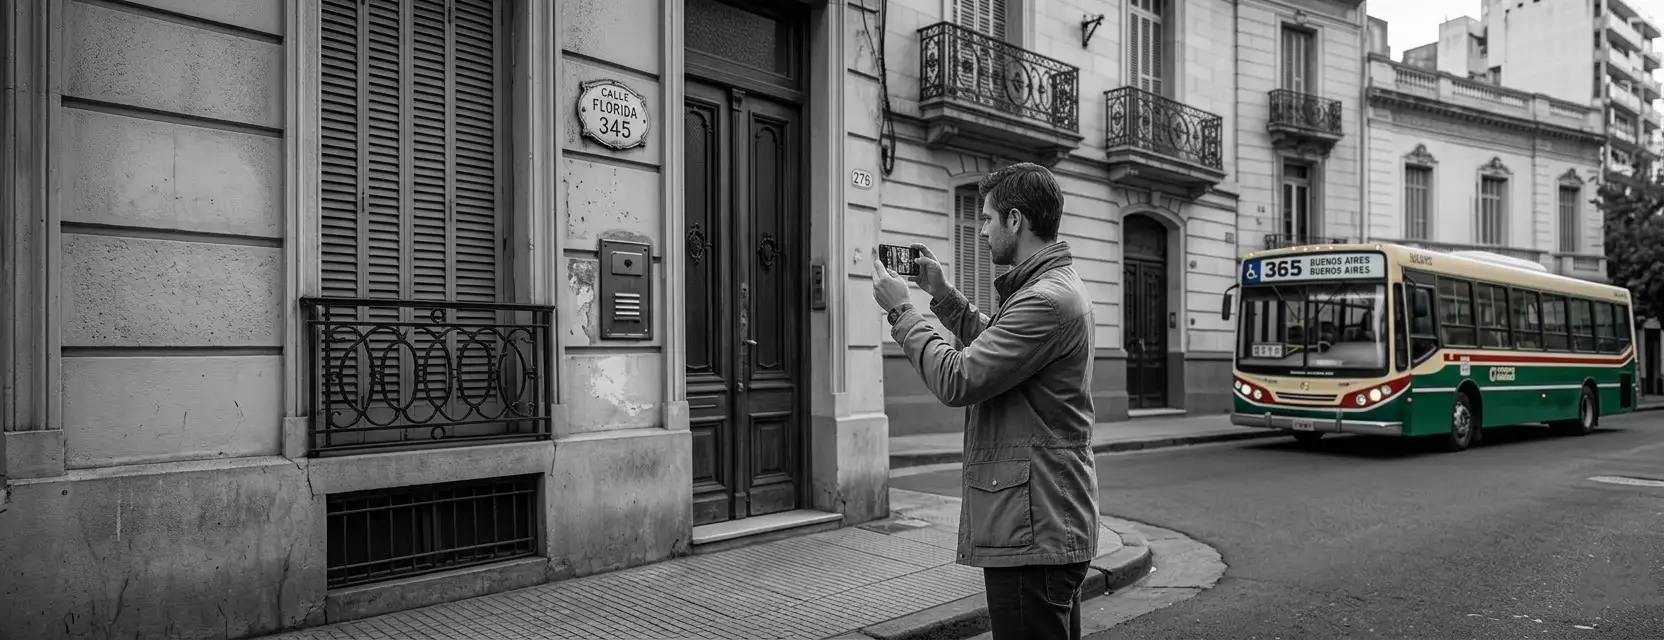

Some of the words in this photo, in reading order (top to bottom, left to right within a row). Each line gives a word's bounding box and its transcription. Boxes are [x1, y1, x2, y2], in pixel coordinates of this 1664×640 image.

[601, 88, 629, 102] CALLE
[593, 98, 637, 119] FLORIDA
[599, 117, 631, 138] 345
[854, 171, 870, 186] 276
[1265, 260, 1302, 278] 365
[1310, 257, 1342, 267] BUENOS
[1344, 256, 1370, 265] AIRES
[1344, 265, 1370, 275] AIRES
